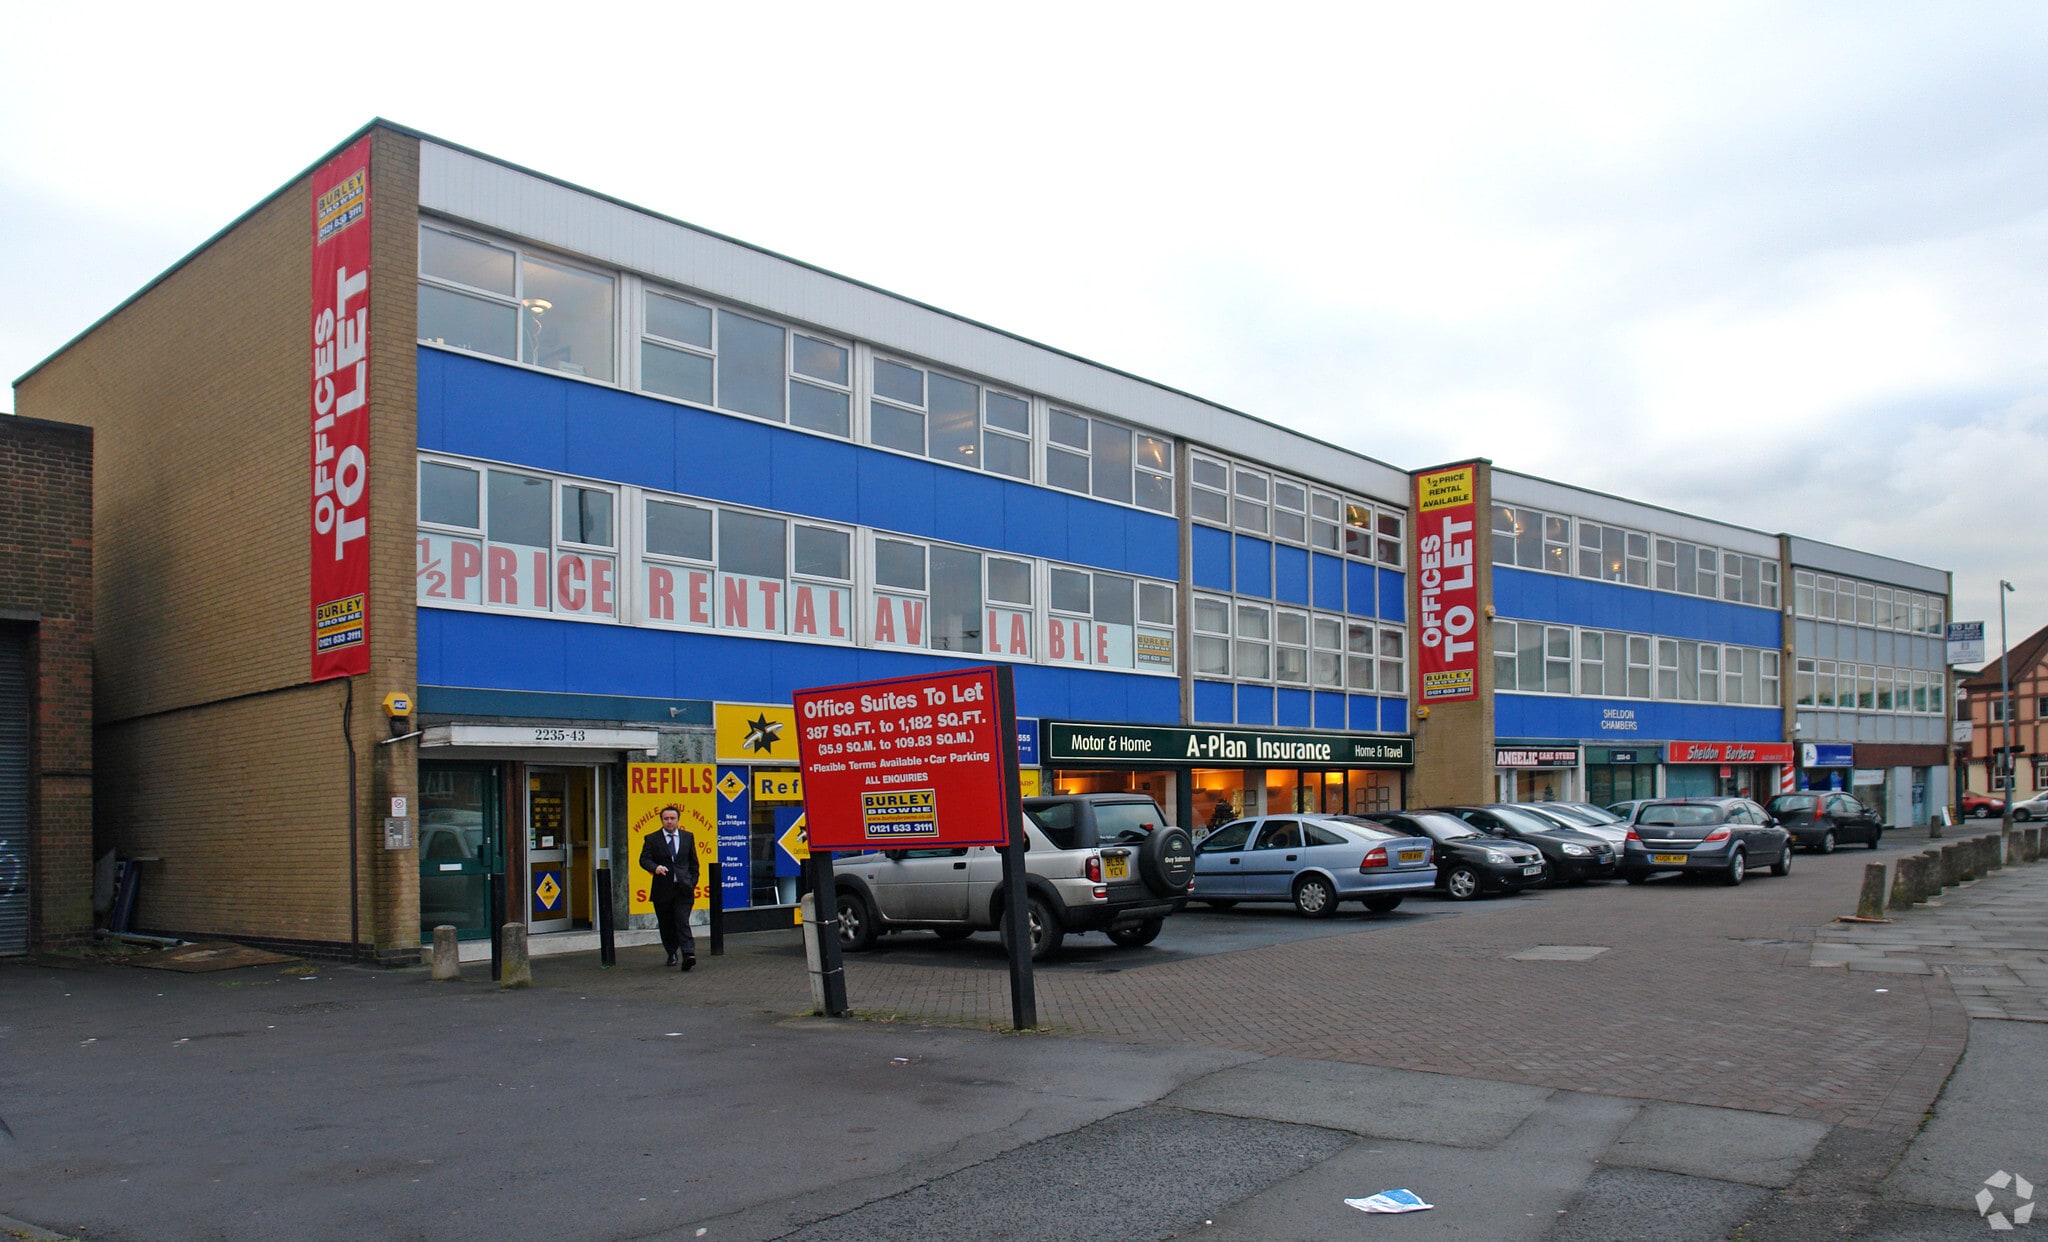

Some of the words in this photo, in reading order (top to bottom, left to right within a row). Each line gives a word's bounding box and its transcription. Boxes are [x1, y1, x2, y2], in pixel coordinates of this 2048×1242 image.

[319, 172, 363, 210] BURLEY
[336, 265, 367, 415] LET
[314, 306, 335, 536] OFFICES
[1439, 473, 1465, 484] PRICE
[1429, 485, 1462, 497] RENTAL
[335, 443, 367, 561] TO
[1423, 494, 1470, 508] AVAILABLE
[1442, 516, 1474, 591] LET
[451, 540, 613, 614] PRICE
[649, 566, 846, 637] RENTAL
[1420, 534, 1442, 648] OFFICES
[318, 598, 362, 620] BURLEY
[318, 612, 361, 628] BROWNE
[1138, 636, 1170, 647] BURLEY
[1444, 605, 1475, 663] TO
[1427, 672, 1471, 681] BURLEY
[803, 699, 855, 719] Office
[860, 690, 918, 713] Suites
[924, 686, 946, 706] To
[952, 682, 984, 703] Let
[1603, 708, 1634, 719] SHELDON
[806, 725, 829, 740] 387
[833, 720, 876, 738] SQ.FT.
[879, 720, 894, 733] to
[898, 715, 933, 733] 1,182
[937, 709, 987, 729] SQ.FT.
[1601, 720, 1637, 730] CHAMBERS
[534, 728, 586, 742] 2235-43
[818, 742, 843, 756] (35.9
[846, 739, 876, 753] SQ.M.
[879, 738, 891, 750] to
[894, 735, 932, 749] 109.83
[936, 730, 975, 746] SQ.M.)
[1071, 734, 1105, 751] Motor
[1108, 735, 1117, 751] &
[1120, 736, 1152, 752] Home
[1186, 732, 1247, 759] A-Plan
[1256, 737, 1331, 760] Insurance
[1354, 744, 1376, 757] Home
[1377, 745, 1383, 757] &
[1383, 745, 1403, 758] Travel
[1687, 744, 1719, 760] Sheldon
[1725, 745, 1756, 760] Barbers
[813, 760, 846, 773] Flexible
[848, 759, 877, 771] Terms
[879, 755, 922, 769] Available
[929, 753, 947, 765] Car
[949, 751, 990, 764] Parking
[1496, 751, 1538, 766] ANGELIC
[631, 767, 714, 794] REFILLS
[761, 779, 799, 794] Ref
[865, 776, 880, 785] ALL
[882, 772, 929, 784] ENQUIRIES
[865, 793, 931, 806] BURLEY
[867, 806, 931, 815] BROWNE
[633, 806, 660, 833] WHILE
[692, 809, 714, 832] WAIT
[869, 825, 891, 833] 0121
[892, 823, 912, 832] 633
[914, 822, 933, 831] 3111
[1109, 867, 1123, 876] YCV
